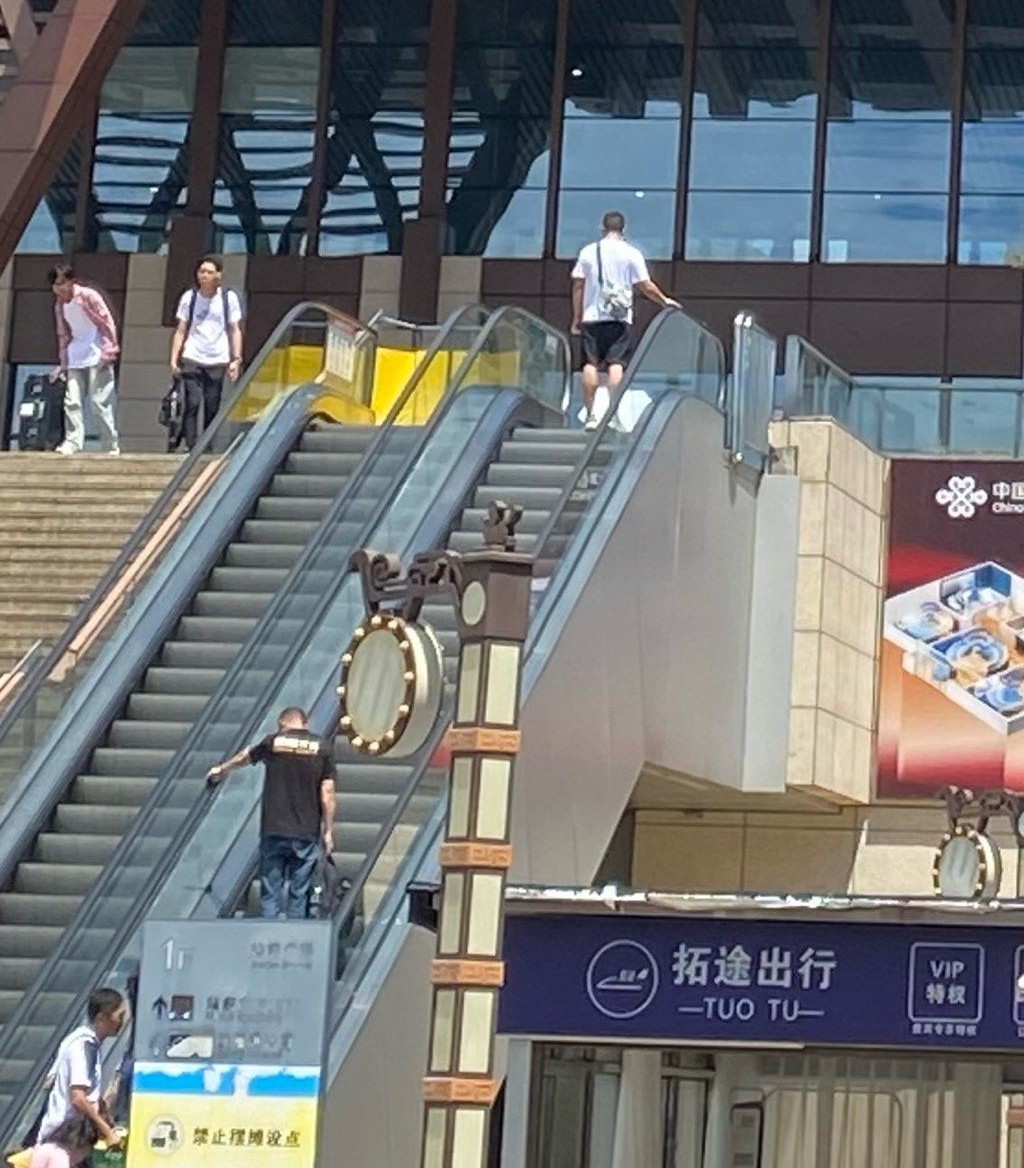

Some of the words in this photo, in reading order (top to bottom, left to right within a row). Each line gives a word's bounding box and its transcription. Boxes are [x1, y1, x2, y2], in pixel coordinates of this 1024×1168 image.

[672, 944, 837, 990] 拓途出行
[929, 959, 965, 980] VIP
[925, 983, 967, 1005] 特权
